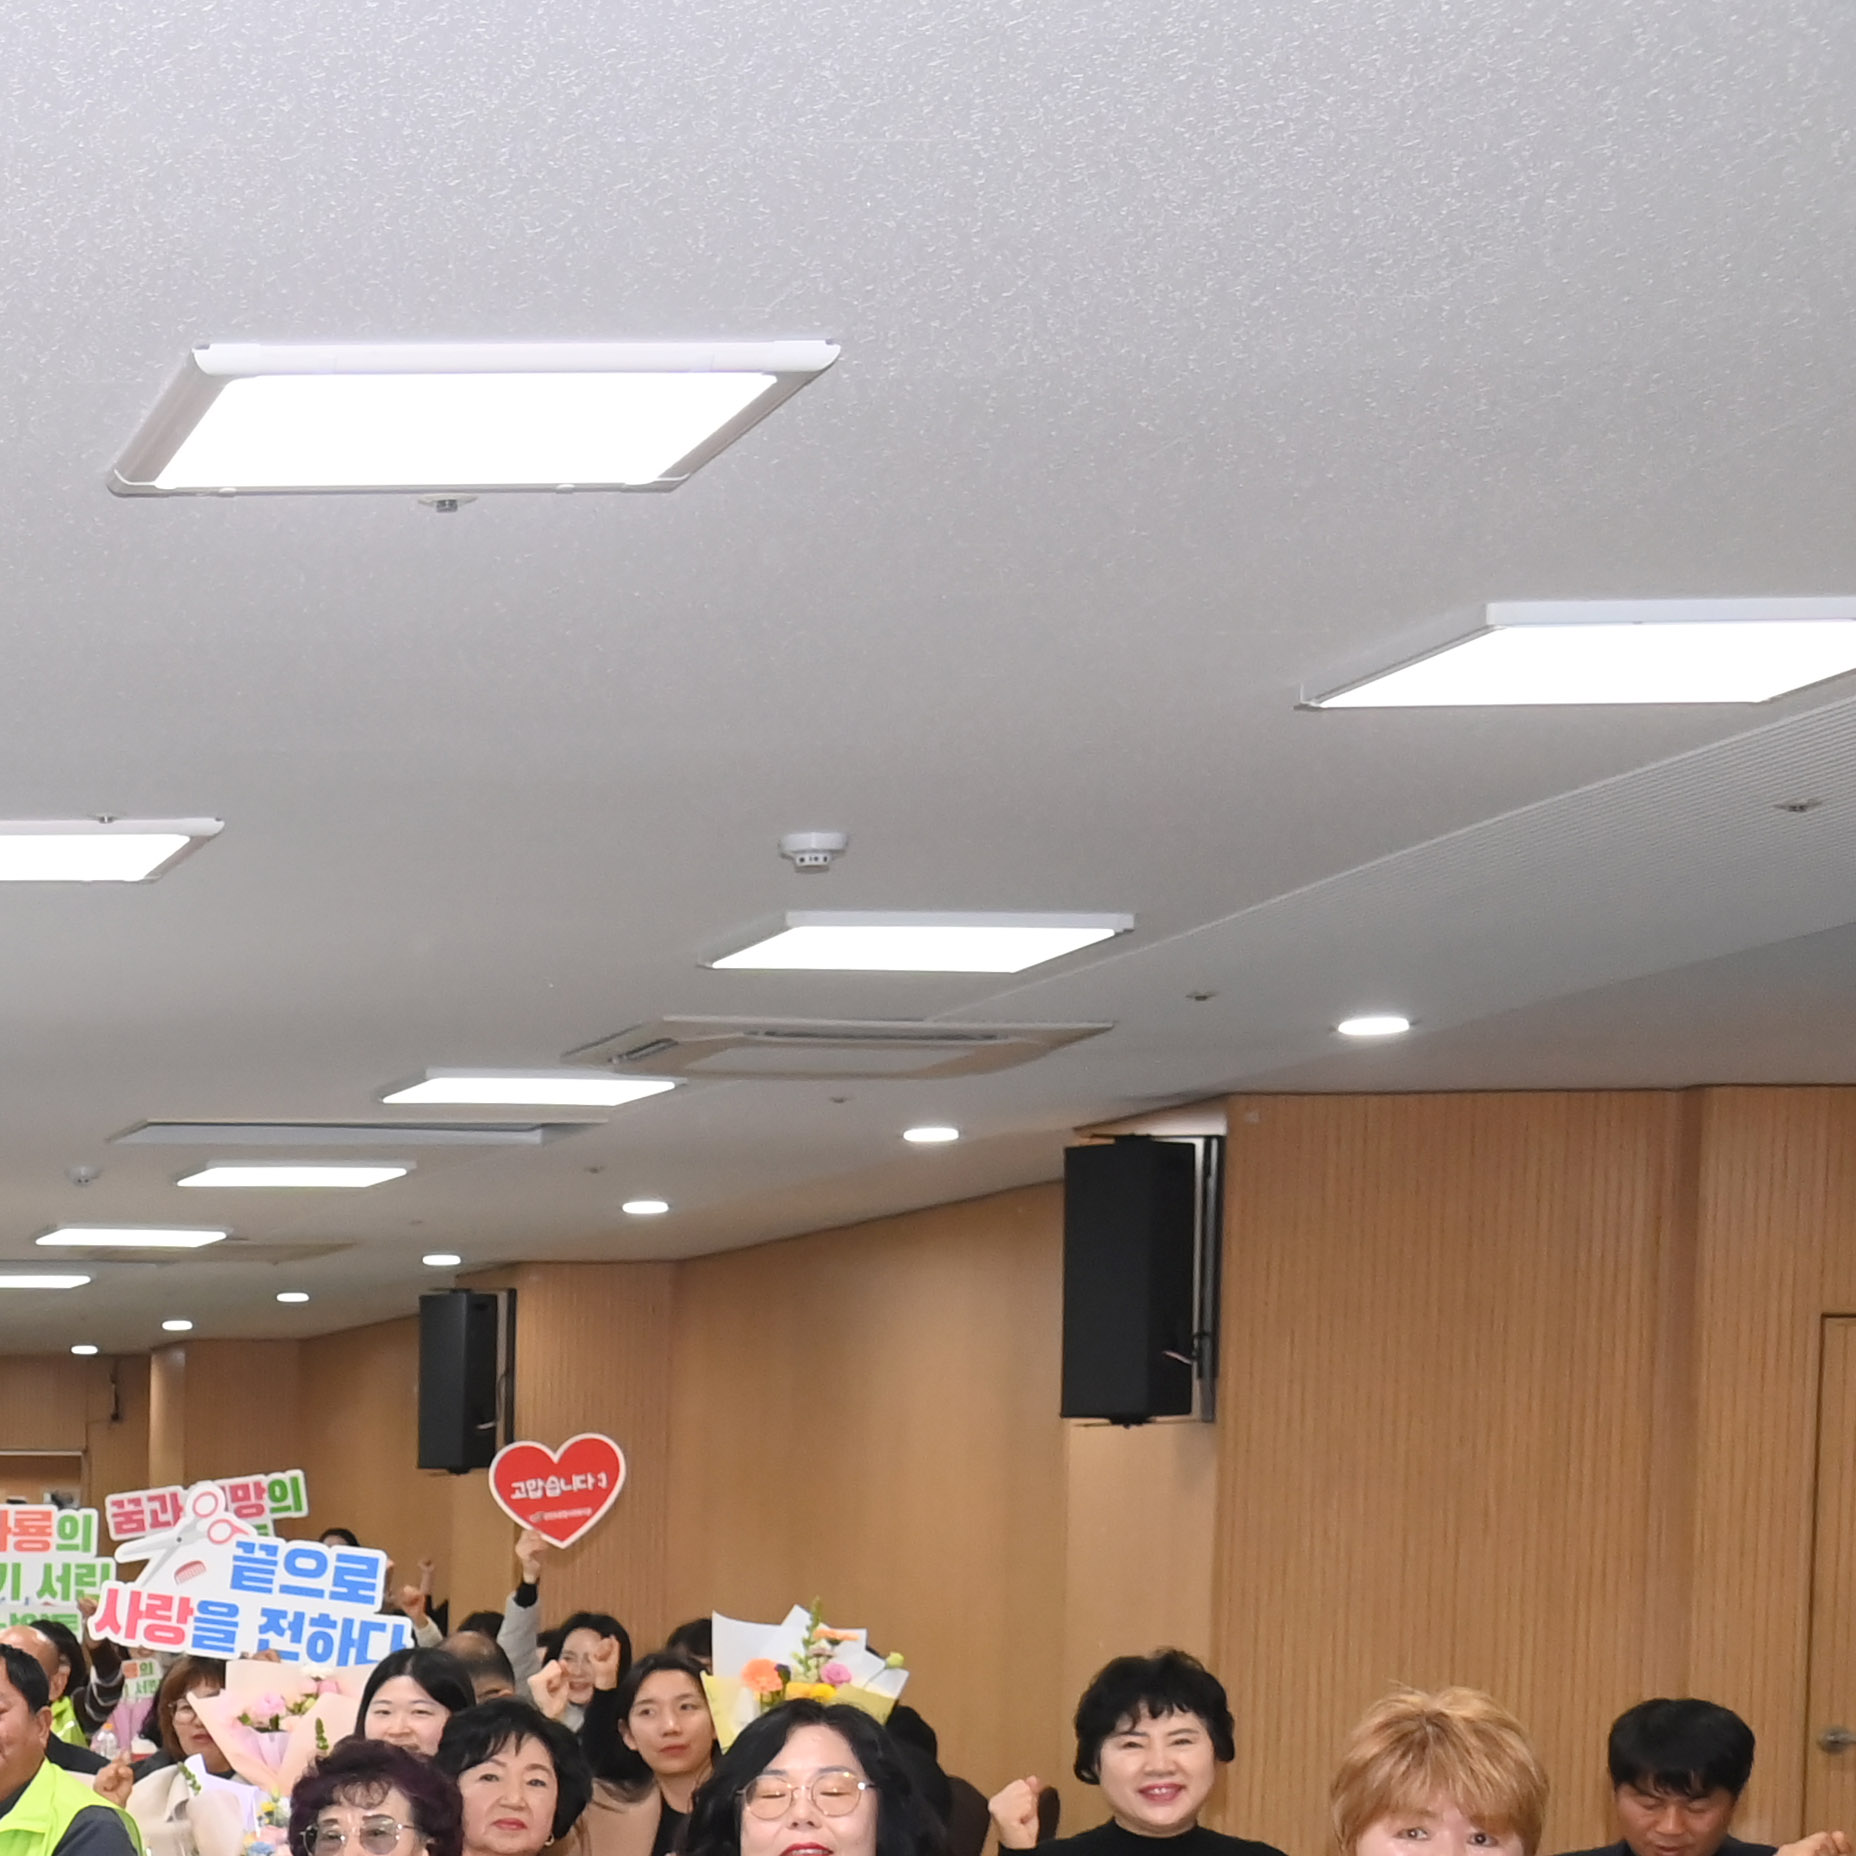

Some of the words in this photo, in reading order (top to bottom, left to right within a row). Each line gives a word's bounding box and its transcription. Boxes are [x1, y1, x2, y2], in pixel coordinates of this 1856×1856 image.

[111, 1492, 183, 1534] 꿈과
[220, 1476, 303, 1519] 망의
[36, 1562, 111, 1602] 서린
[95, 1587, 239, 1653] 사랑을
[258, 1606, 407, 1667] 전하다
